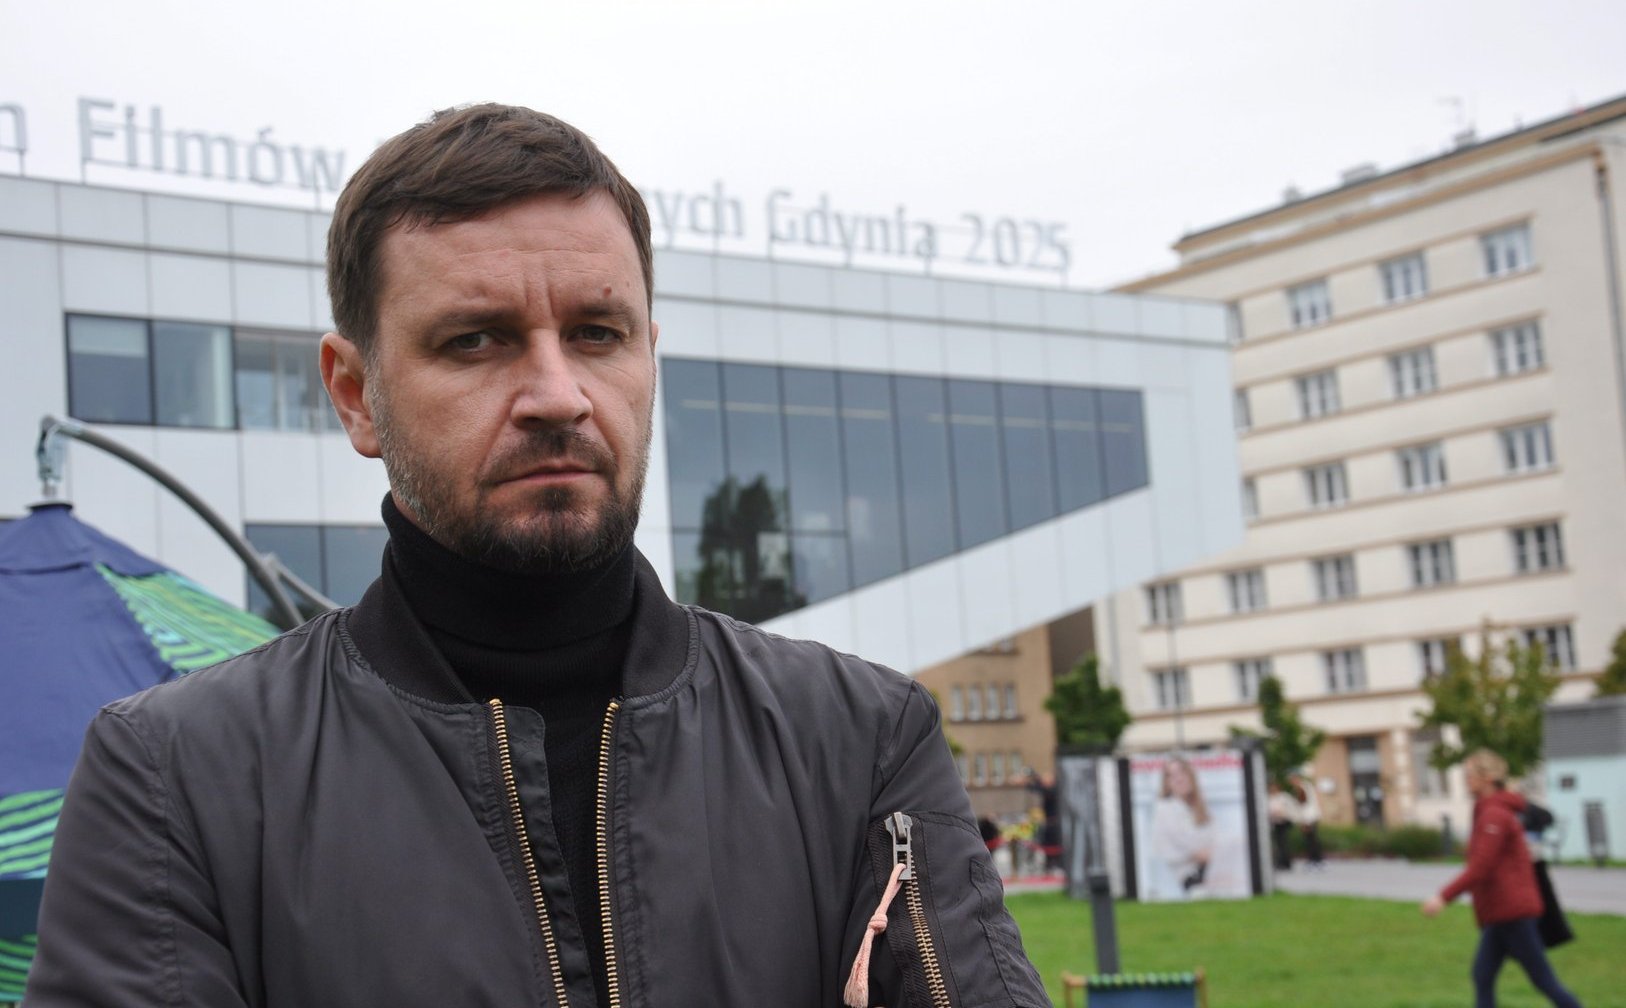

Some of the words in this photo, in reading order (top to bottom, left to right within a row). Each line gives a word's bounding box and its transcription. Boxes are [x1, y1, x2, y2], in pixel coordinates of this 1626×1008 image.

[77, 95, 346, 192] Filmów
[646, 179, 744, 248] ych
[766, 187, 938, 267] Gdynia
[960, 212, 1072, 272] 2025
